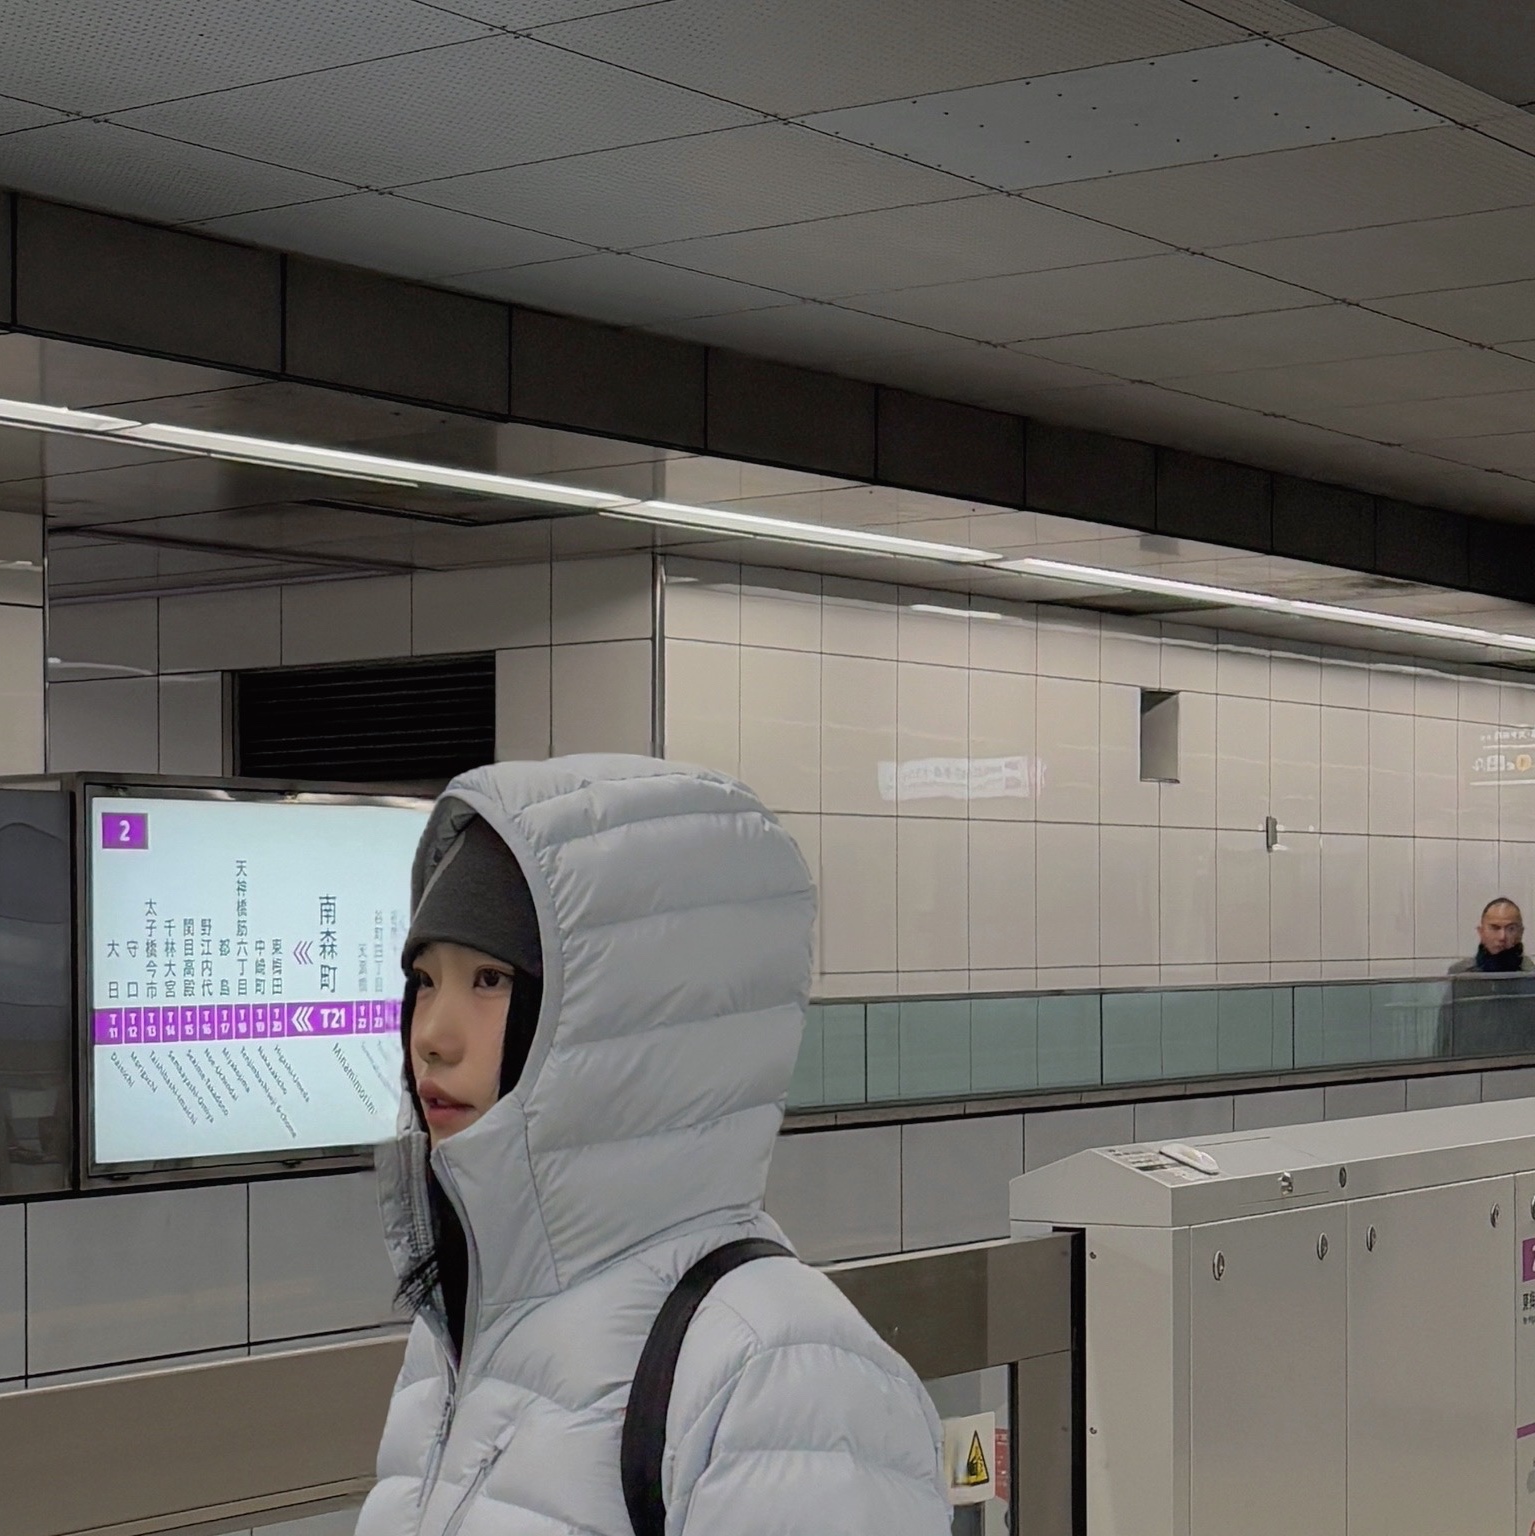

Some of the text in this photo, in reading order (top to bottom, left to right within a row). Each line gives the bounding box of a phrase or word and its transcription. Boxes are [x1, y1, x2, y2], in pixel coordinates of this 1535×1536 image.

[119, 820, 131, 842] 2
[107, 940, 120, 999] 大日
[127, 940, 139, 998] 守口
[145, 898, 158, 999] 太子橋今市
[164, 918, 176, 998] 千林大宮
[201, 918, 213, 997] 野江内代
[319, 893, 338, 993] 南森町
[109, 1027, 118, 1038] 11
[320, 1008, 345, 1028] T21
